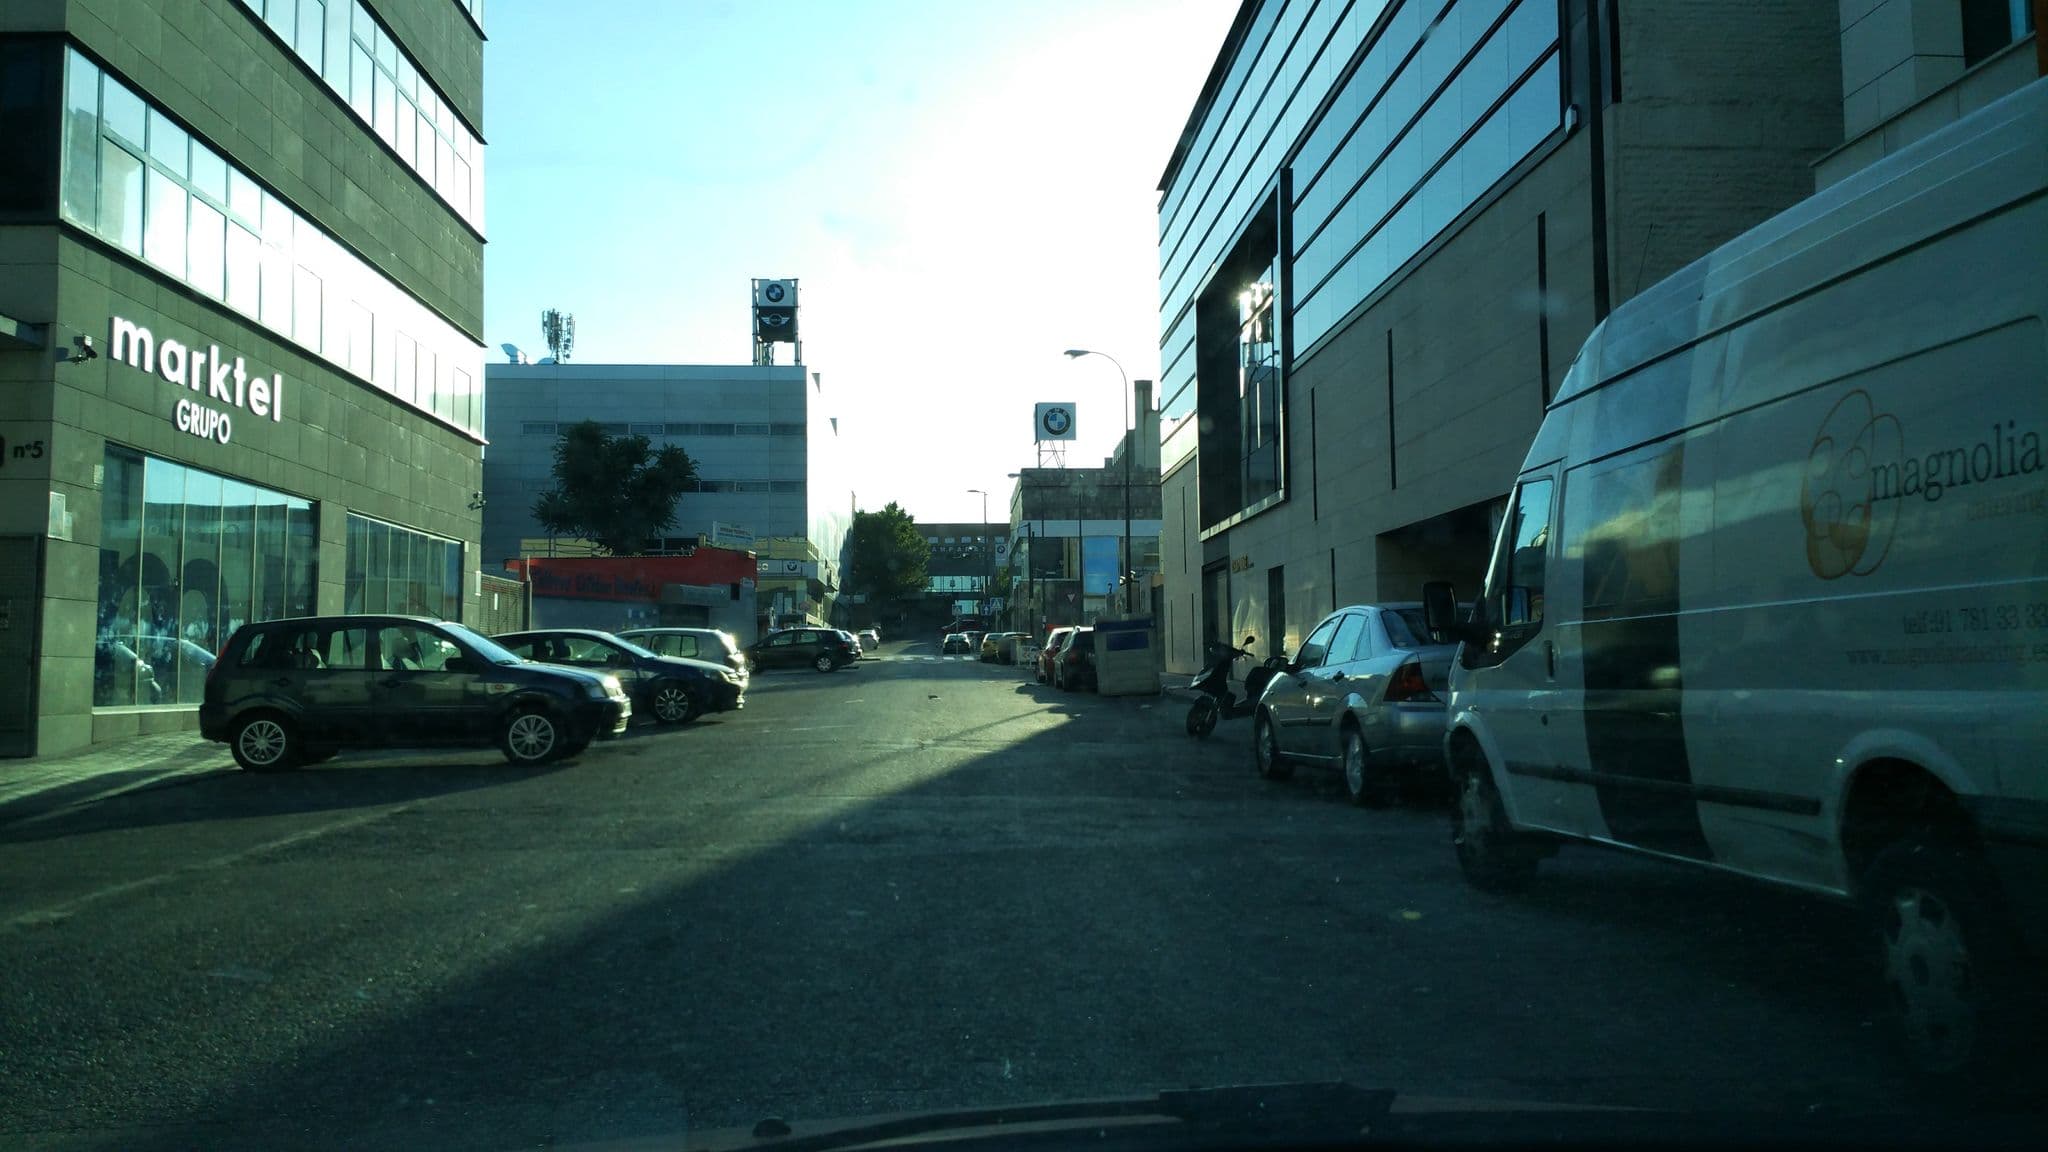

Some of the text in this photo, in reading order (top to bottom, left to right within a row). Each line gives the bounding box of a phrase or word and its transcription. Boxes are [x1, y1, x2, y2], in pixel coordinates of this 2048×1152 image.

[110, 316, 282, 422] marktel
[174, 398, 231, 444] GRUPO
[1872, 420, 2045, 501] magnolia
[1959, 607, 1990, 632] 781
[1996, 604, 2021, 631] 33
